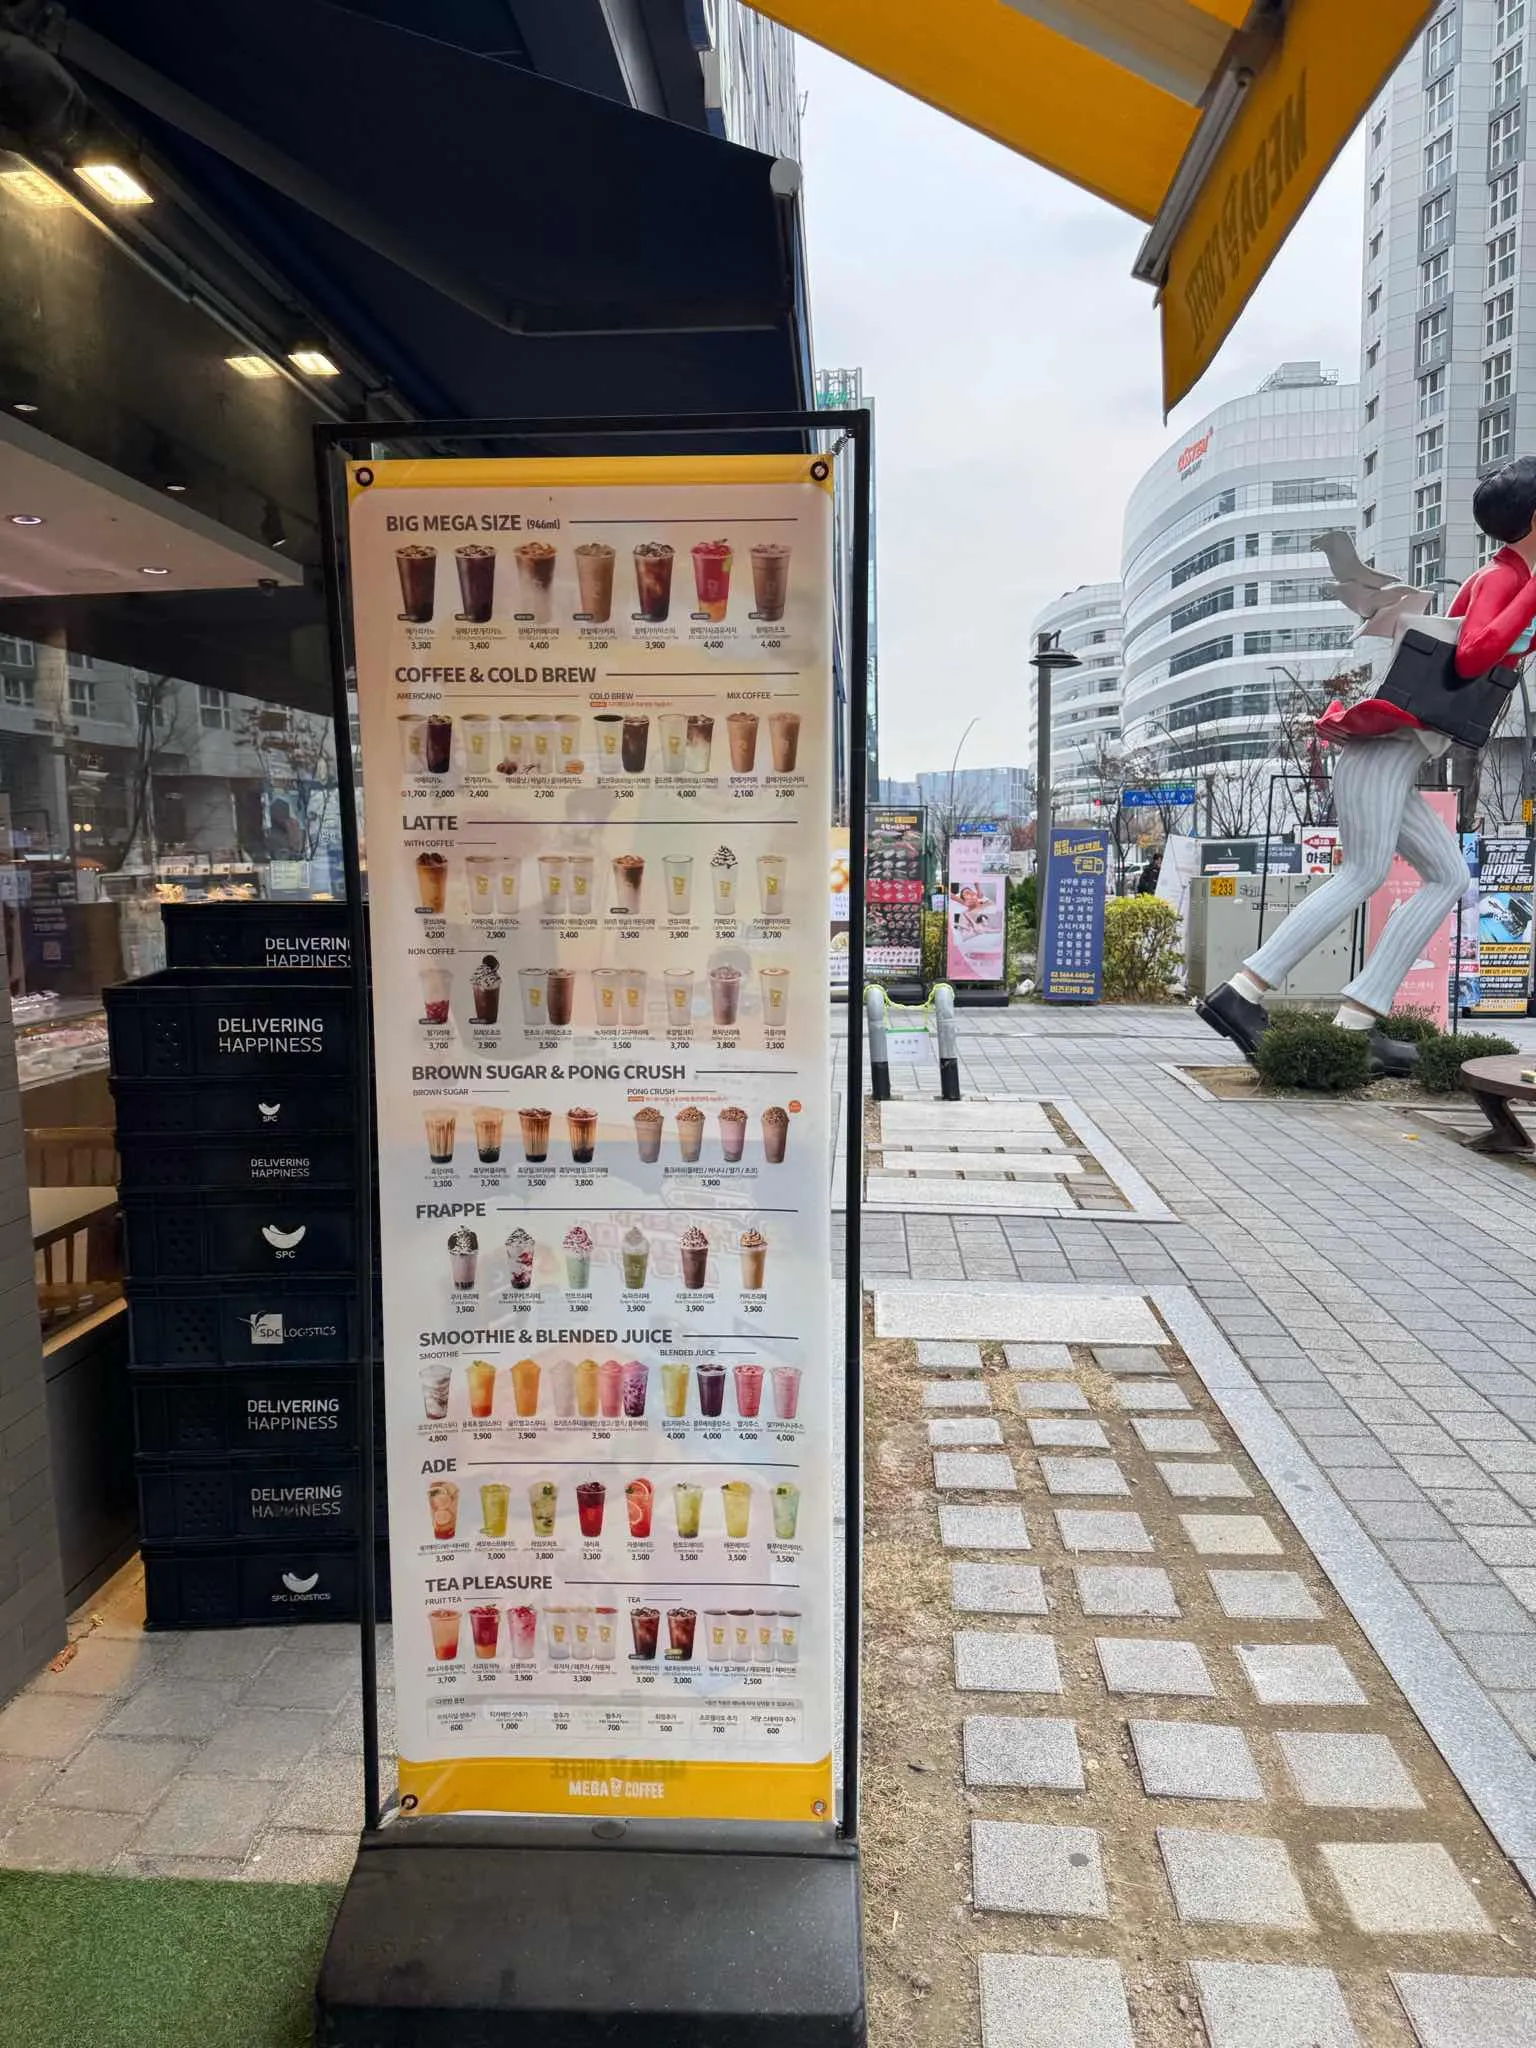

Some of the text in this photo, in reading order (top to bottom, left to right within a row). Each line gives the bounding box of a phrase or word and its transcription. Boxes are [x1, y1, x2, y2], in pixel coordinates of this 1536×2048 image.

[386, 515, 419, 532] BIG
[423, 515, 478, 531] MEGA
[481, 514, 521, 531] SIZE
[470, 641, 490, 650] 3,400
[529, 641, 549, 650] 4,400
[645, 641, 665, 650] 3,900
[704, 641, 724, 650] 4,400
[761, 640, 780, 649] 4,400
[395, 667, 597, 684] COFFEE & COLD BREW
[397, 692, 442, 700] AMERICANO
[590, 692, 634, 700] COLD BREW
[727, 692, 771, 700] MIX COFFEE
[408, 790, 427, 799] 1,700
[435, 790, 455, 799] 2,000
[469, 790, 489, 799] 2,400
[535, 790, 555, 799] 2,700
[614, 790, 634, 798] 3,500
[677, 790, 697, 798] 4,000
[734, 790, 753, 798] 2,100
[402, 816, 458, 830] LATTE
[1219, 882, 1232, 896] 233
[425, 931, 445, 939] 4,200
[560, 931, 579, 939] 3,400
[669, 931, 689, 939] 3,900
[716, 931, 735, 939] 3,900
[762, 931, 782, 939] 3,700
[265, 937, 350, 950] DELIVERIN
[266, 954, 350, 968] HAPPINES
[218, 1018, 324, 1033] DELIVERING
[219, 1037, 322, 1052] HAPPINESS
[412, 1065, 686, 1080] BROWN SUGAR & PONG CRUSH
[627, 1088, 649, 1096] PONG
[250, 1158, 310, 1167] DELIVERING
[251, 1168, 310, 1177] HAPPINESS
[480, 1179, 500, 1187] 3,700
[527, 1179, 546, 1187] 3,500
[575, 1179, 594, 1187] 3,800
[702, 1179, 720, 1187] 3,900
[416, 1203, 486, 1219] FRAPPE
[275, 1250, 296, 1259] SPC
[283, 1326, 336, 1338] LOGISTICS
[419, 1329, 672, 1347] SMOOTHIE & BLENDED JUICE
[419, 1350, 459, 1360] SMOOTHIE
[247, 1400, 339, 1413] DELIVERING
[248, 1416, 338, 1430] HAPPINESS
[428, 1434, 448, 1442] 4,800
[473, 1432, 492, 1440] 3,900
[518, 1432, 536, 1440] 3,900
[592, 1432, 611, 1440] 3,900
[666, 1432, 685, 1440] 4,000
[703, 1432, 722, 1440] 4,000
[739, 1432, 758, 1440] 4,000
[776, 1434, 795, 1442] 4,000
[421, 1458, 457, 1474] ADE
[251, 1485, 342, 1501] DELIVERING
[436, 1554, 455, 1562] 3,900
[488, 1552, 506, 1560] 3,000
[536, 1552, 554, 1560] 3,800
[680, 1553, 698, 1561] 3,500
[728, 1553, 746, 1561] 3,500
[776, 1555, 794, 1563] 3,500
[425, 1576, 552, 1593] TEA PLEASURE
[272, 1594, 288, 1602] SPC
[425, 1598, 447, 1606] FRUIT
[437, 1676, 456, 1684] 3,700
[477, 1674, 496, 1682] 3,500
[744, 1678, 762, 1686] 2,500
[608, 1724, 620, 1732] 700
[568, 1780, 664, 1799] MEGA COFFEE
